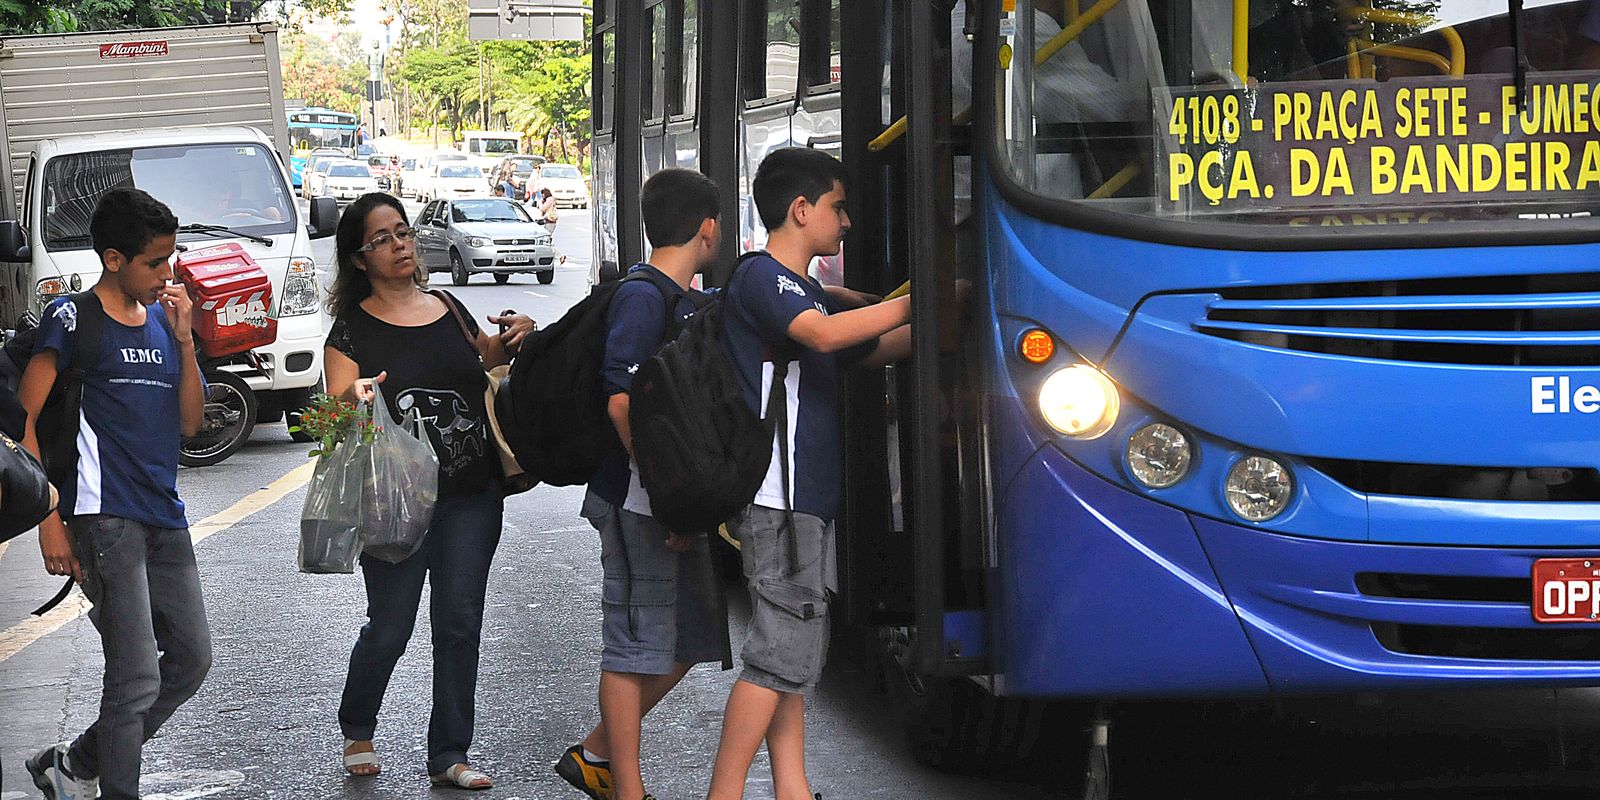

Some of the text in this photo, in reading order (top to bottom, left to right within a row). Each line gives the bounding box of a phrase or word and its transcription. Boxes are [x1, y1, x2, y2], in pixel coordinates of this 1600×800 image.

[103, 42, 166, 56] Mambrini
[1169, 94, 1241, 145] 4108
[1274, 90, 1384, 144] PRAÇA
[1395, 87, 1468, 139] SETE
[1169, 141, 1600, 206] PÇA. DA BANDEIRA
[120, 348, 163, 364] IEMG
[1531, 376, 1600, 414] Ele
